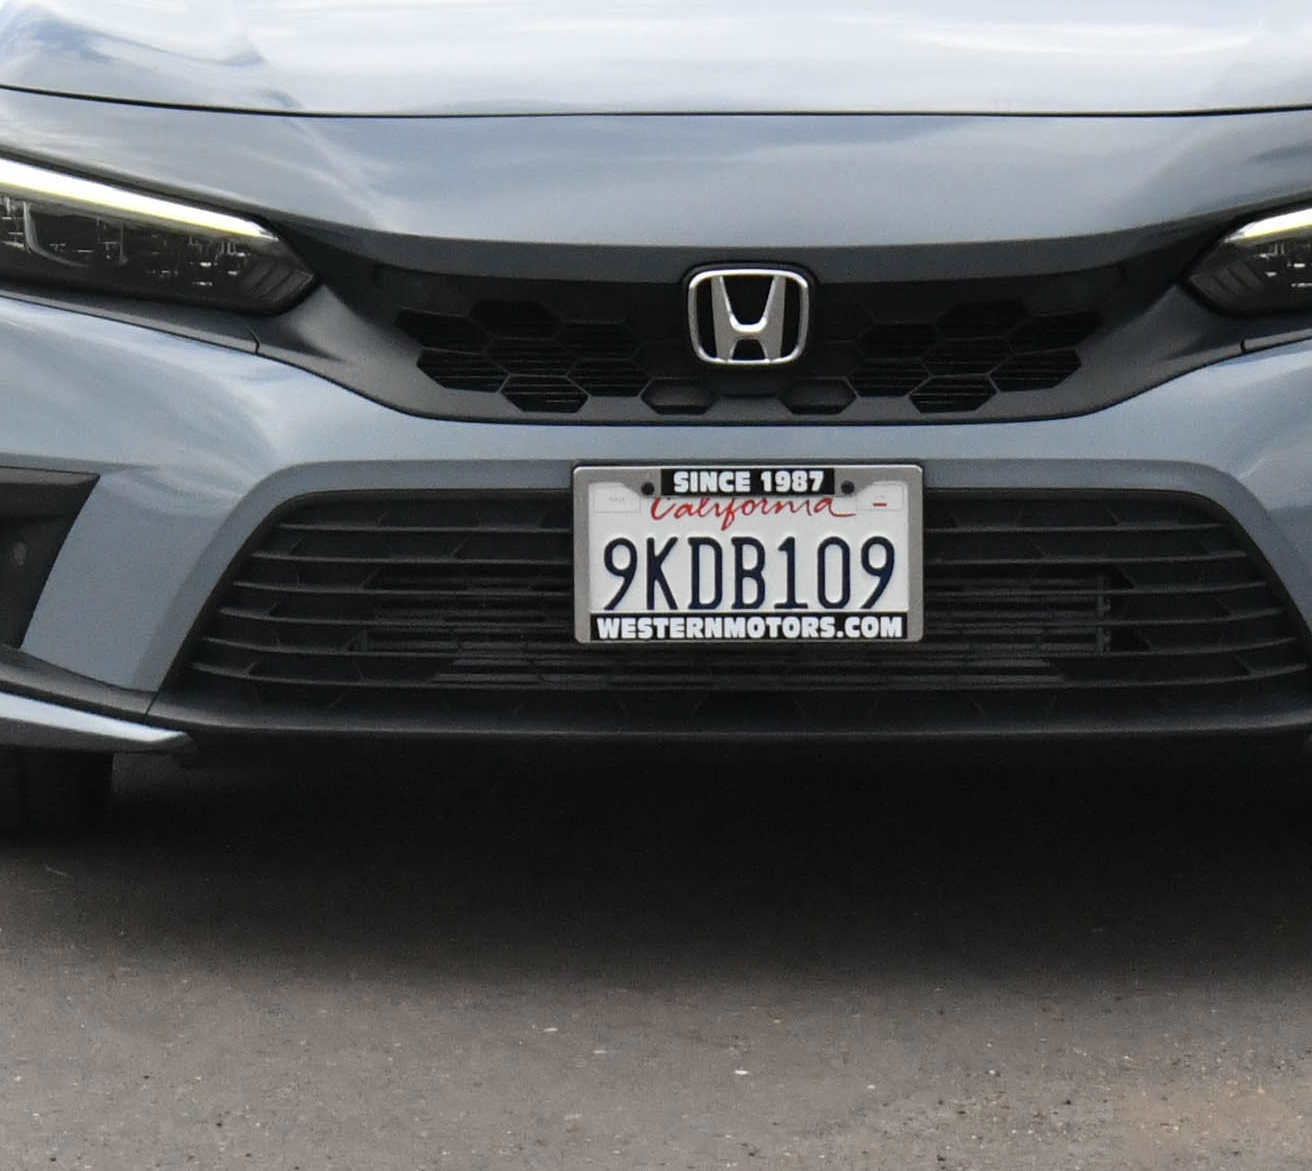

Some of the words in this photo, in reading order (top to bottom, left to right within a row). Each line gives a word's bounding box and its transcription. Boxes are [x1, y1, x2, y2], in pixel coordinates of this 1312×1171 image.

[672, 470, 751, 493] SINCE
[760, 470, 825, 493] 1987
[649, 496, 856, 530] California
[603, 535, 896, 611] 9KDB109
[596, 616, 903, 640] WESTERNMOTORS.COM
